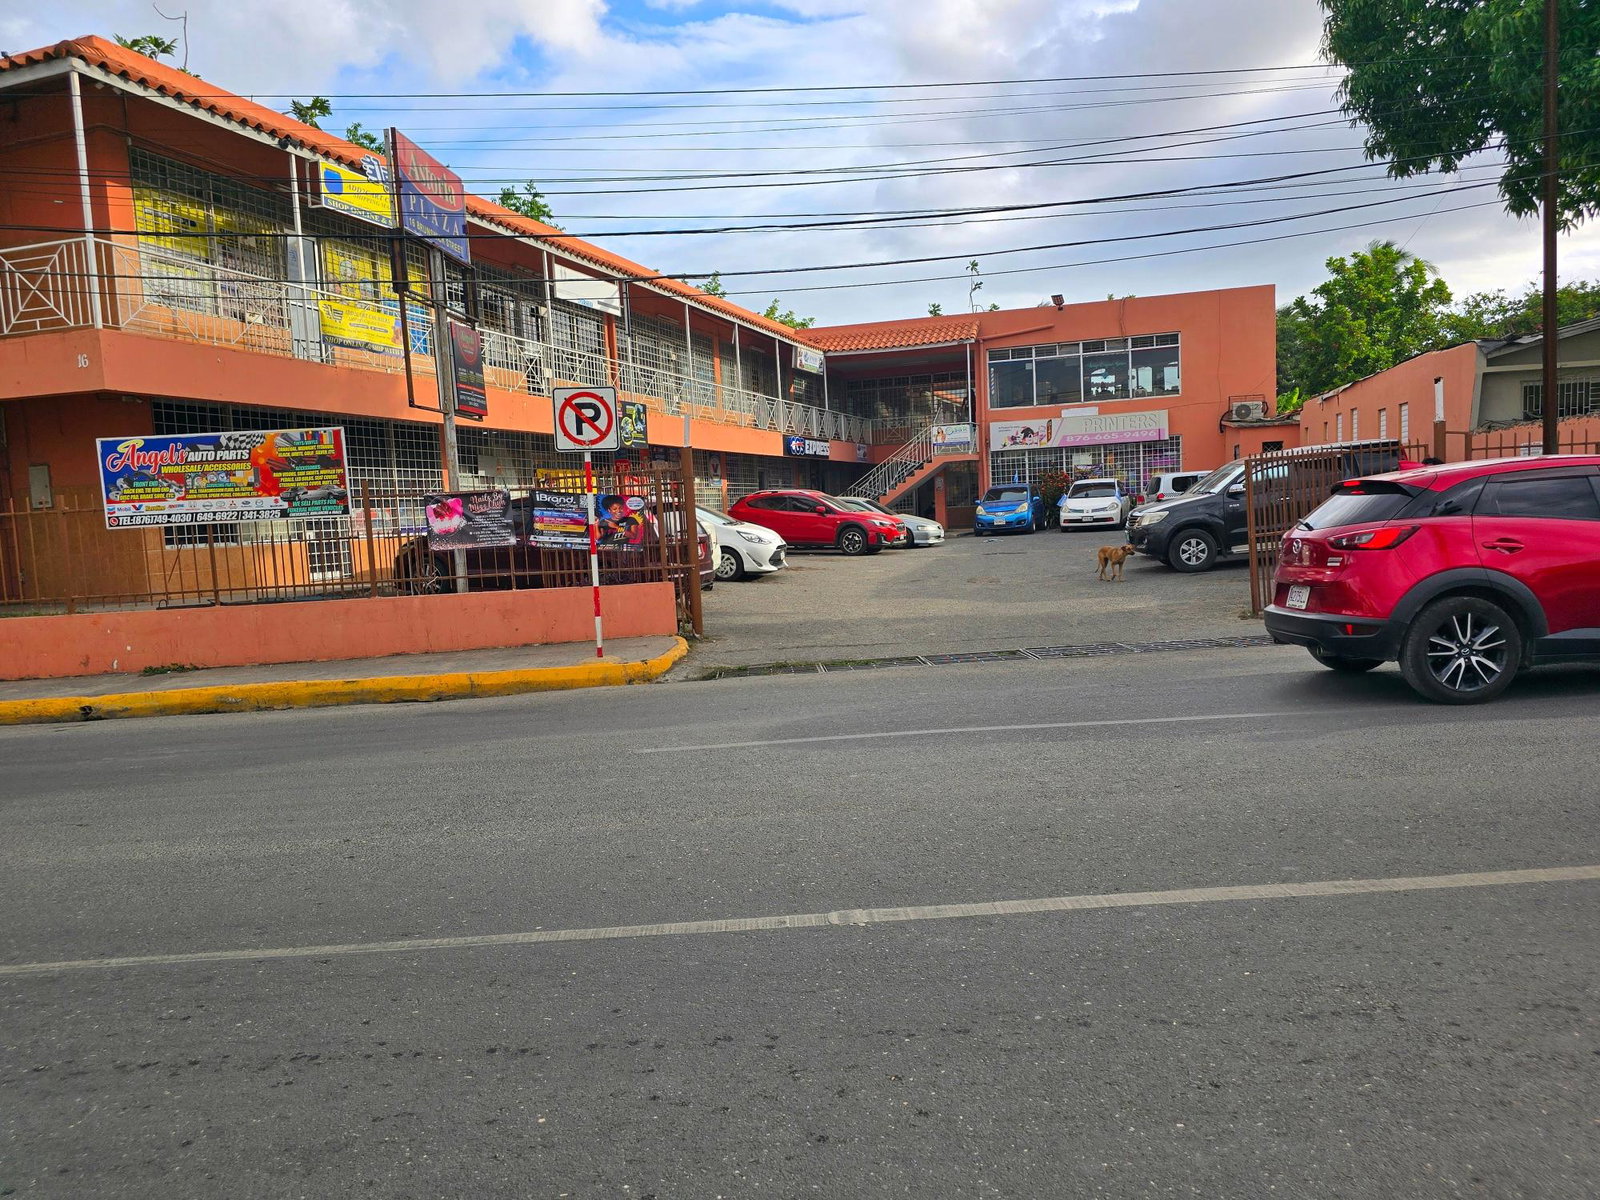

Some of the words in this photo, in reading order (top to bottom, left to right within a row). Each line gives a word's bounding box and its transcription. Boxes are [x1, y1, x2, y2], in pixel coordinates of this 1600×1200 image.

[408, 150, 457, 207] Astoria
[327, 198, 350, 211] SHOP
[350, 207, 381, 222] ONLINE
[409, 191, 460, 236] PLAZA
[324, 336, 344, 346] SHOP
[343, 339, 366, 348] ONLINE
[77, 352, 89, 368] 16
[1083, 413, 1158, 433] PRINTERS
[1066, 429, 1157, 442] 876-665-9496
[106, 442, 188, 475] Angel's
[187, 451, 215, 461] AUTO
[216, 449, 250, 460] PARTS
[161, 462, 252, 474] WHOLESALE/ACCESSORIES
[196, 511, 238, 522] 649-6922
[242, 510, 281, 520] 341-3825
